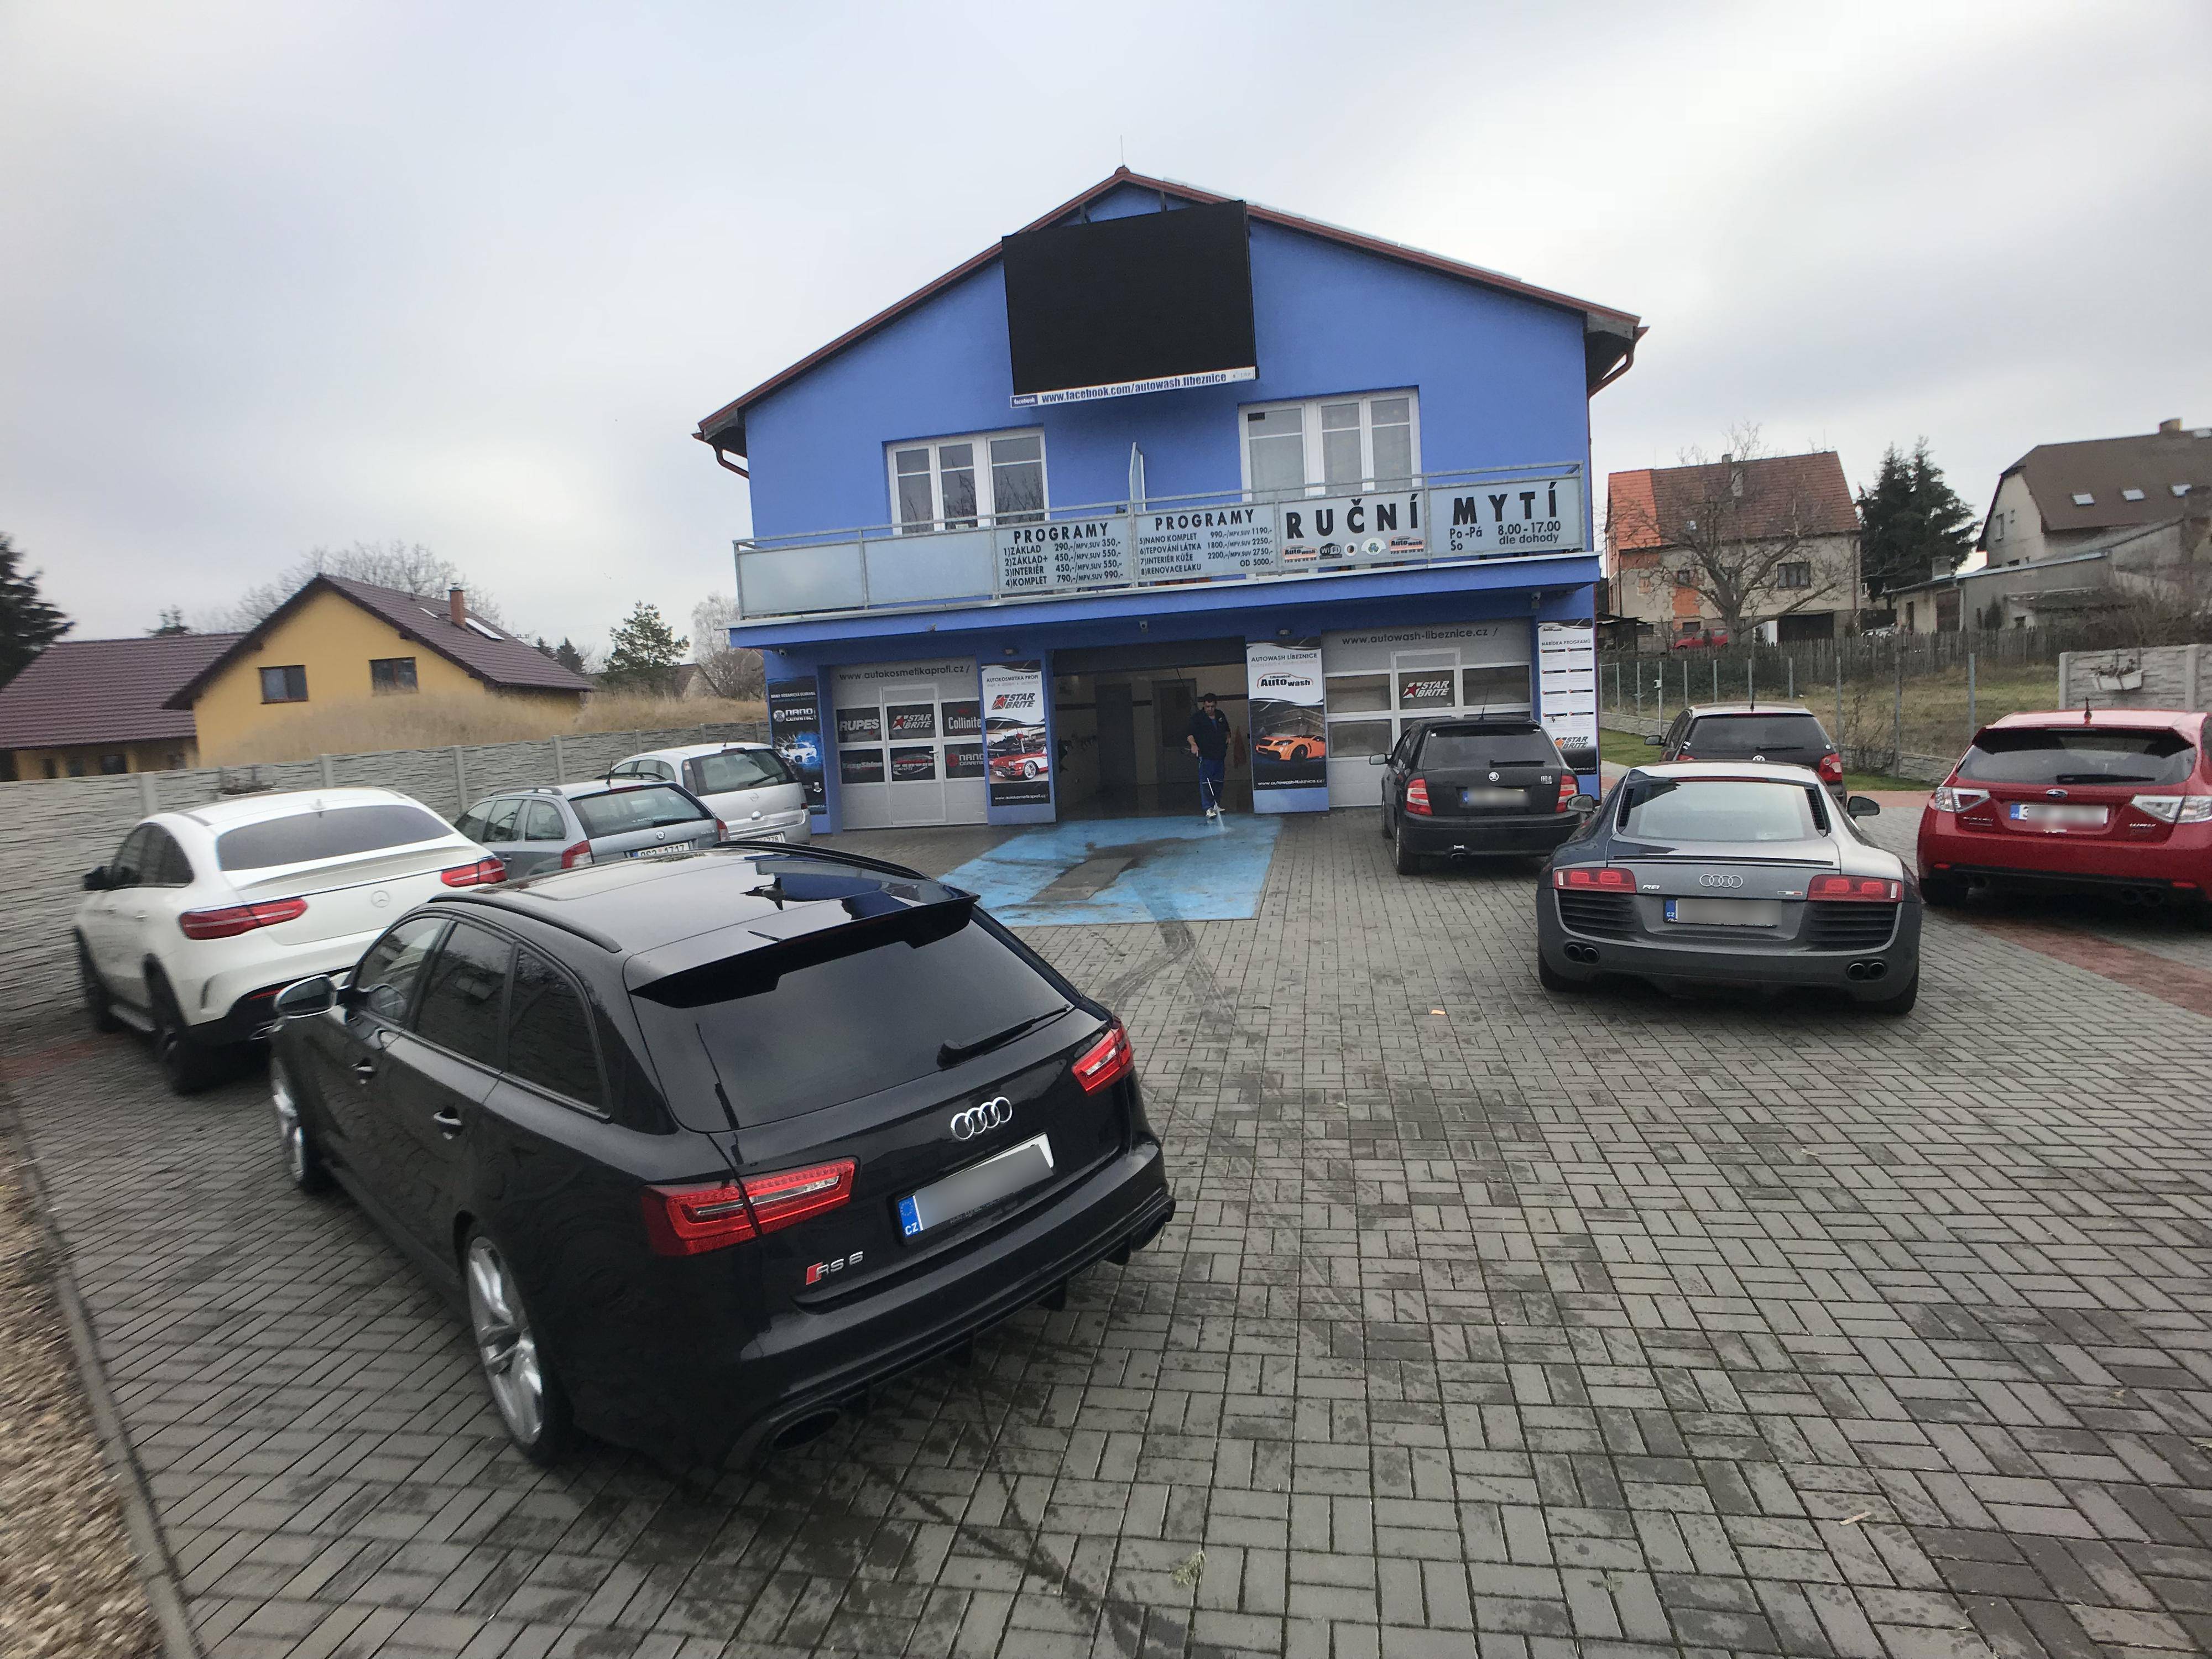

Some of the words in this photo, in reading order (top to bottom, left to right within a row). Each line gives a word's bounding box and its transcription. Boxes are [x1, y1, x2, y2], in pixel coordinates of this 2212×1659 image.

[1041, 373, 1227, 403] www.facebook.com/autowash.libeznice
[1286, 493, 1419, 539] RUČNÍ
[1453, 481, 1557, 526] MYTÍ
[1155, 509, 1254, 531] PROGRAMY
[1014, 522, 1109, 545] PROGRAMY
[1498, 523, 1521, 536] 8.00
[1530, 520, 1561, 534] 17.00
[1102, 538, 1121, 547] 350,-
[1167, 533, 1197, 542] KOMPLET
[1450, 539, 1463, 551] So
[1499, 535, 1516, 545] dle
[1519, 532, 1559, 544] dohody
[1180, 542, 1202, 552] LÁTKA
[1102, 549, 1121, 559] 550,-
[1103, 559, 1123, 569] 550,-
[1183, 564, 1202, 572] LAKU
[1240, 559, 1251, 567] OD
[1005, 576, 1048, 588] 4)KOMPLET
[1104, 570, 1124, 580] 990,-
[1342, 629, 1488, 645] www.autowash-libeznice.cz
[1260, 679, 1287, 687] Auto
[1421, 680, 1450, 689] STAR
[1009, 692, 1035, 702] STAR
[1416, 688, 1450, 698] BRITE
[1005, 700, 1035, 709] BRITE
[907, 713, 932, 722] STAR
[948, 716, 982, 729] Collinite
[838, 718, 880, 732] RUPES
[903, 721, 932, 729] BRITE
[904, 1222, 919, 1236] CZ
[815, 1258, 844, 1280] RS
